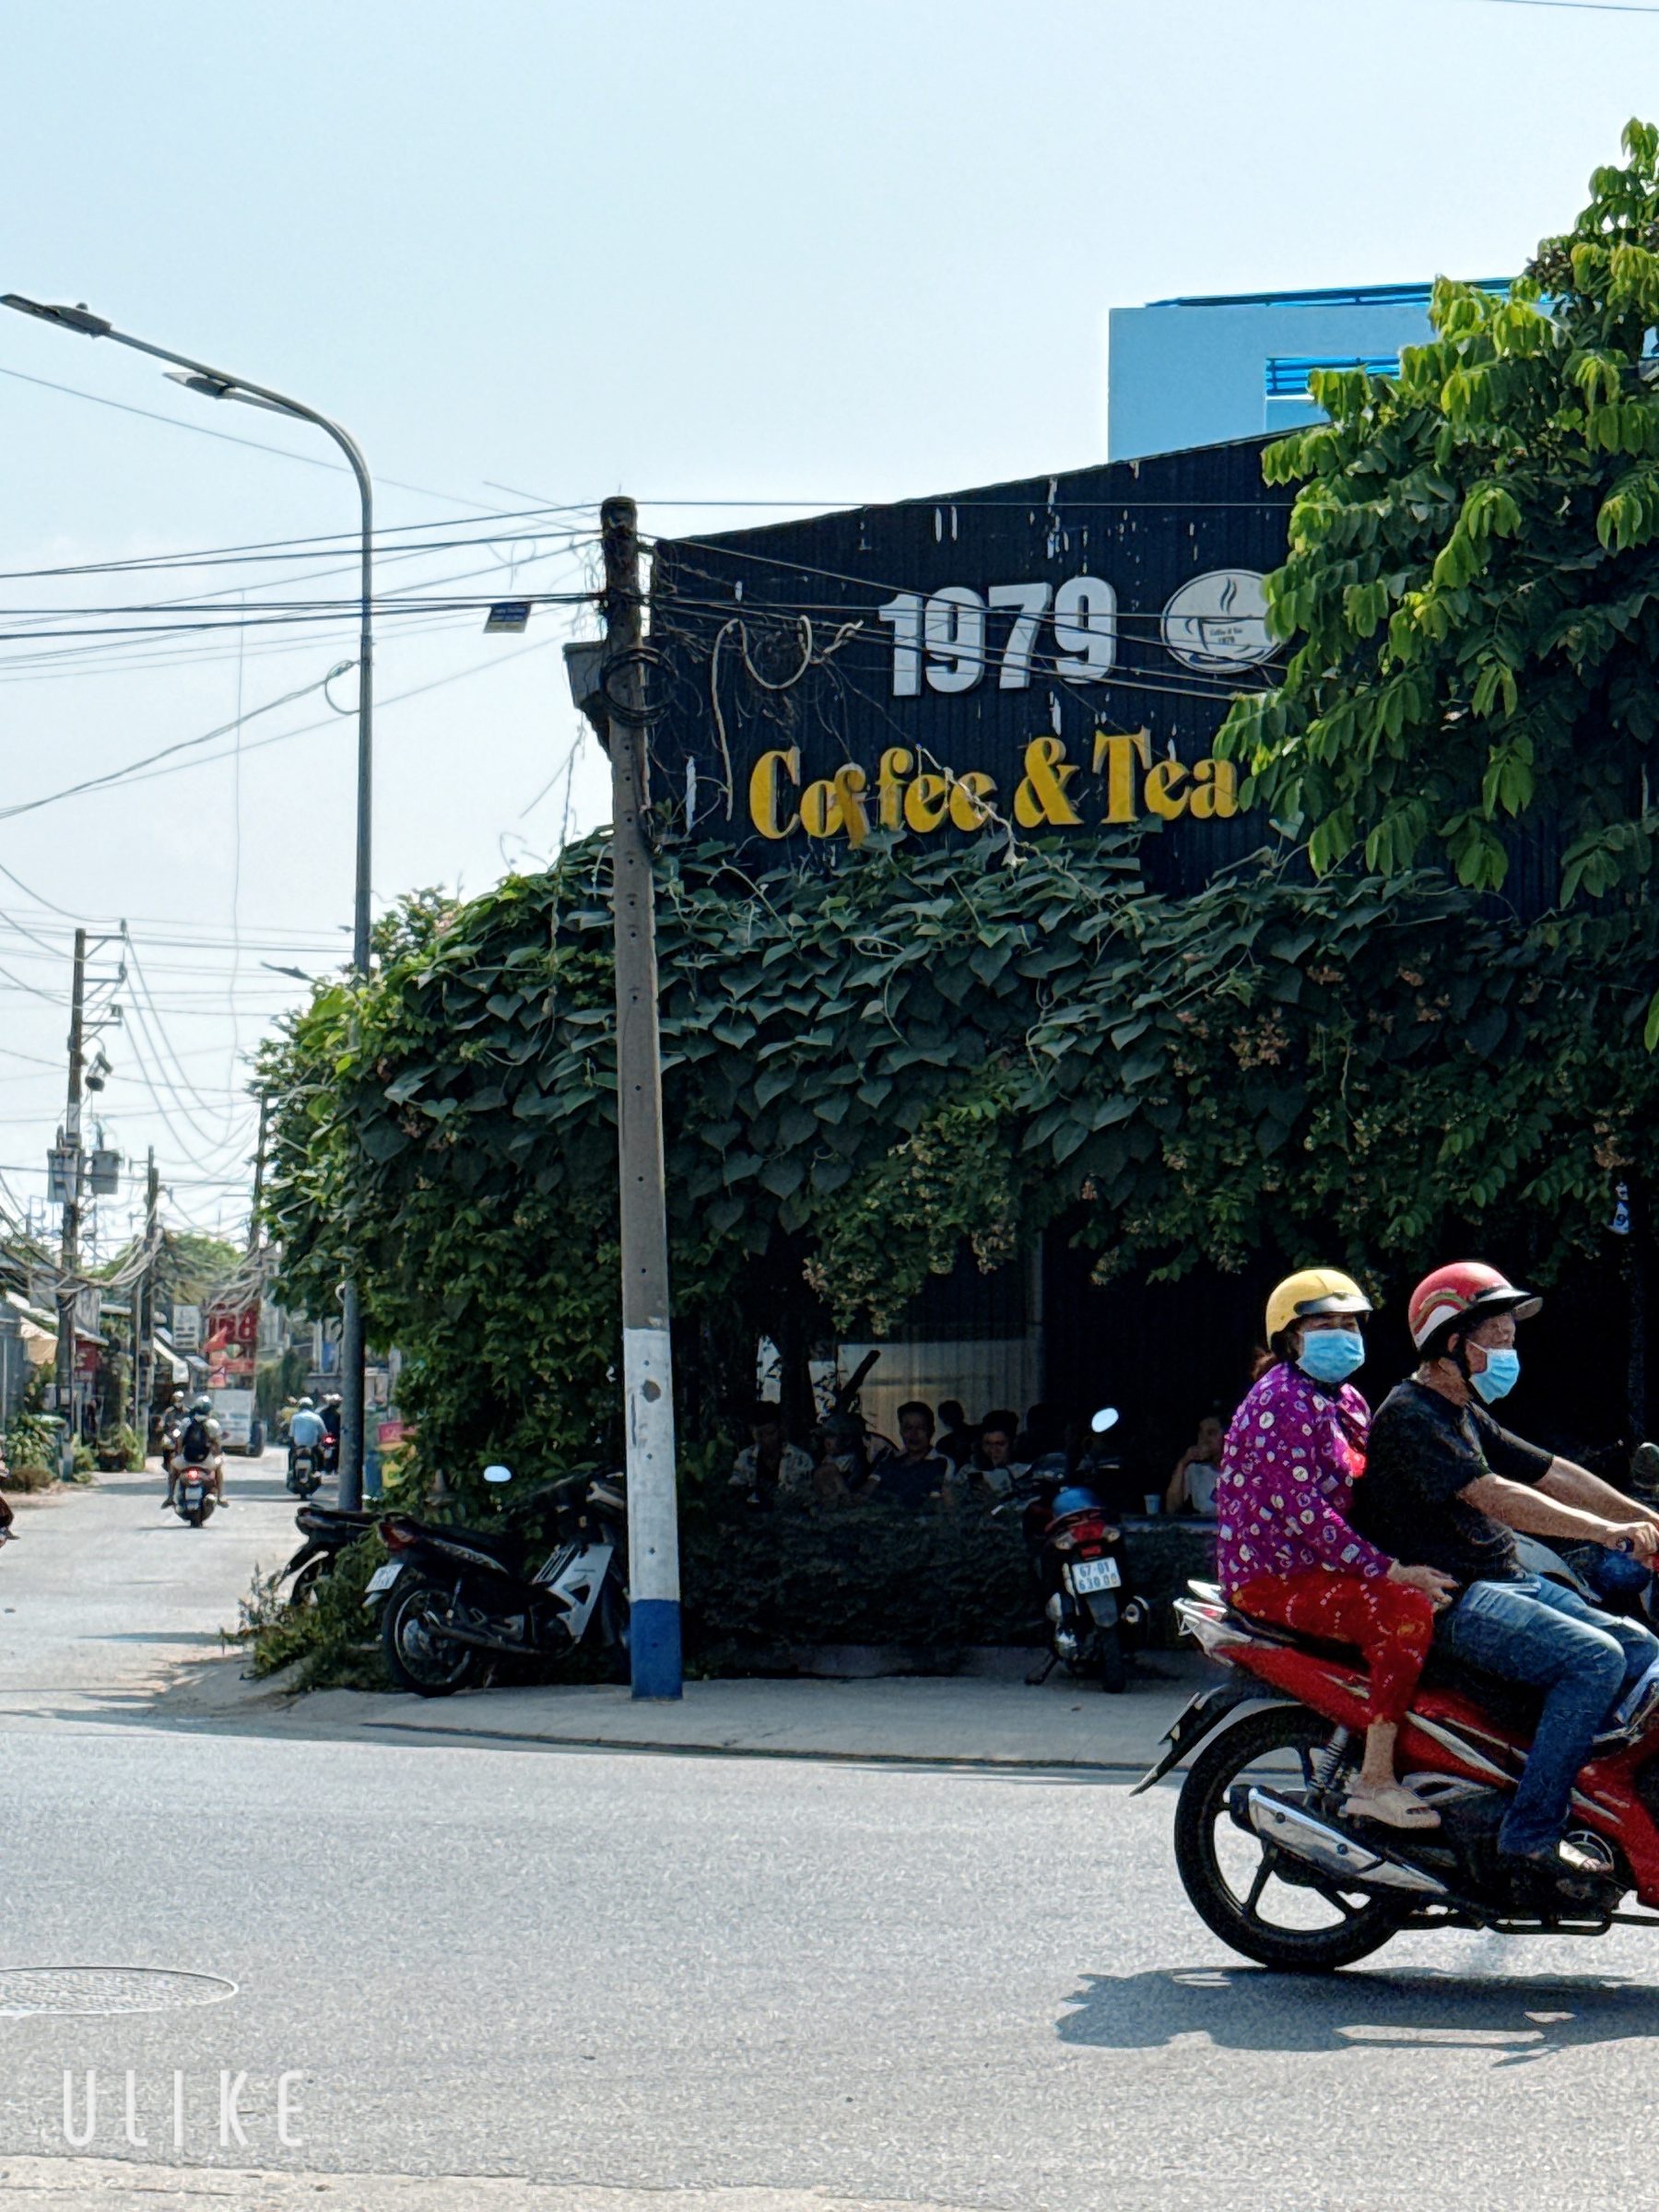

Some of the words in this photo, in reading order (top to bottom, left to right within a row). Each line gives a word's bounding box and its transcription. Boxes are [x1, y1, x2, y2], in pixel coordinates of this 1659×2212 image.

[878, 576, 1117, 697] 1979
[749, 746, 998, 851] Coffee
[1015, 736, 1085, 829] &
[1092, 725, 1239, 821] Tea
